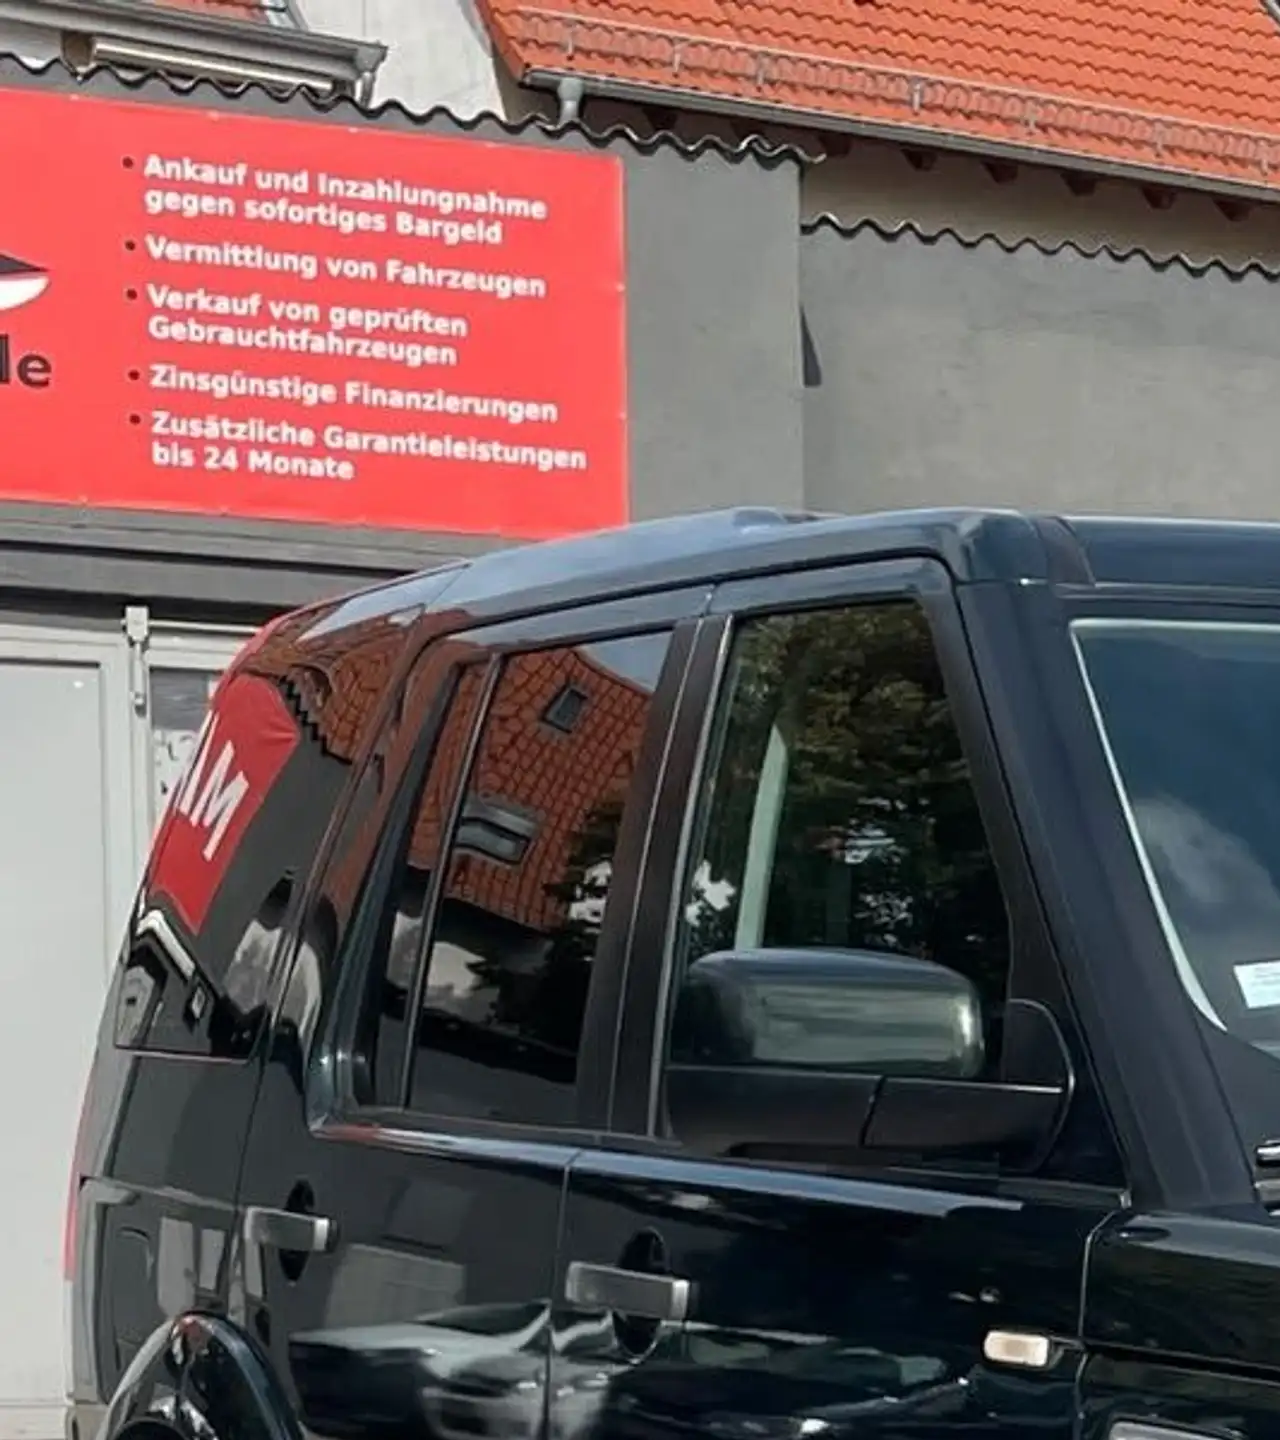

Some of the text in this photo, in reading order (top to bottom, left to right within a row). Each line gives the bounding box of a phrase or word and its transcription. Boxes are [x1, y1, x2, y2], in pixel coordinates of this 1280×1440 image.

[143, 153, 547, 220] Ankauf und Inzahlungnahme
[144, 189, 503, 246] gegen sofortiges Bargeld
[145, 236, 546, 300] Vermittlung von Fahrzeugen
[146, 282, 468, 341] Verkauf von geprüften
[147, 314, 458, 368] Gebrauchtfahrzeugen
[149, 363, 558, 424] Zinsgünstige Finanzierungen
[151, 411, 587, 472] Zusätzliche Garantieleistungen
[152, 440, 354, 480] bis 24 Monate
